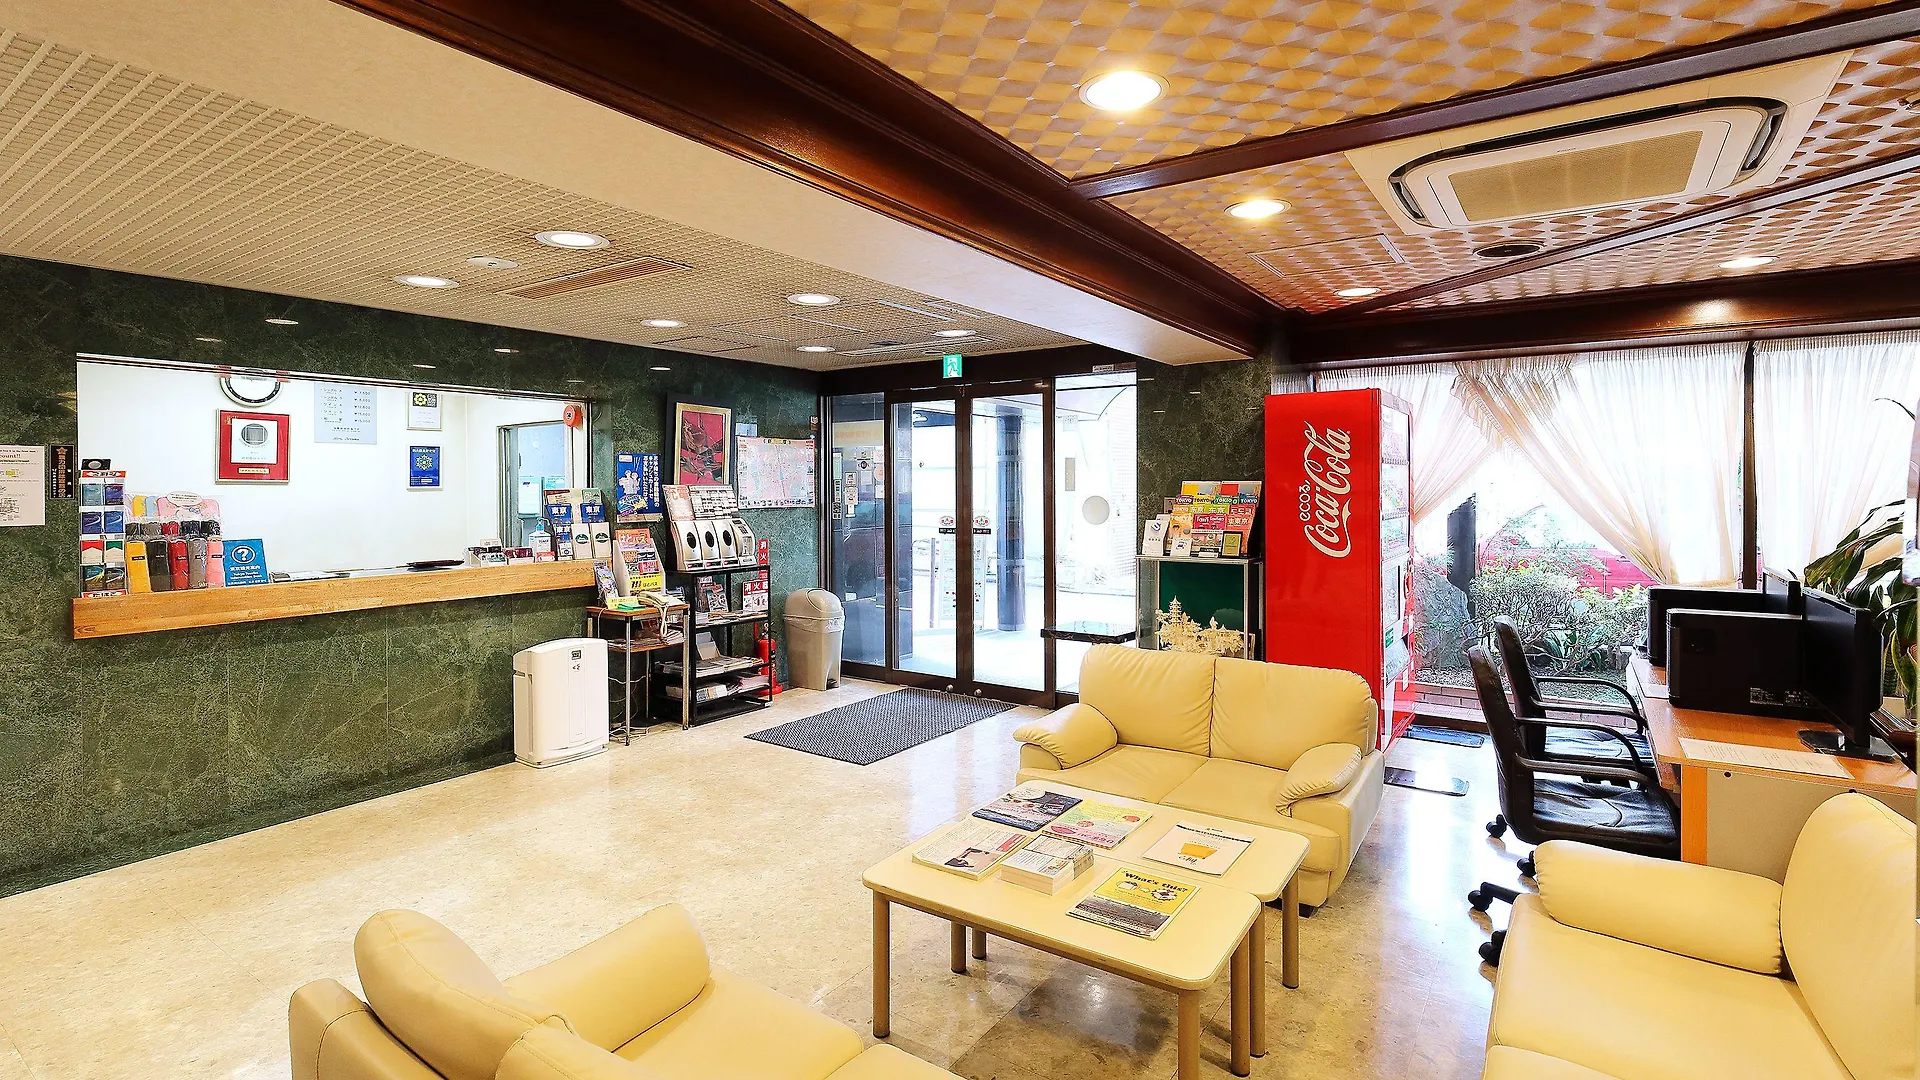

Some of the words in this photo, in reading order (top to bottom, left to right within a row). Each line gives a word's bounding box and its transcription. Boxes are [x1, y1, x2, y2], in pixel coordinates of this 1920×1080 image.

[1303, 420, 1352, 558] Coca-Cola
[619, 532, 649, 546] はとバス
[1125, 871, 1159, 886] What's
